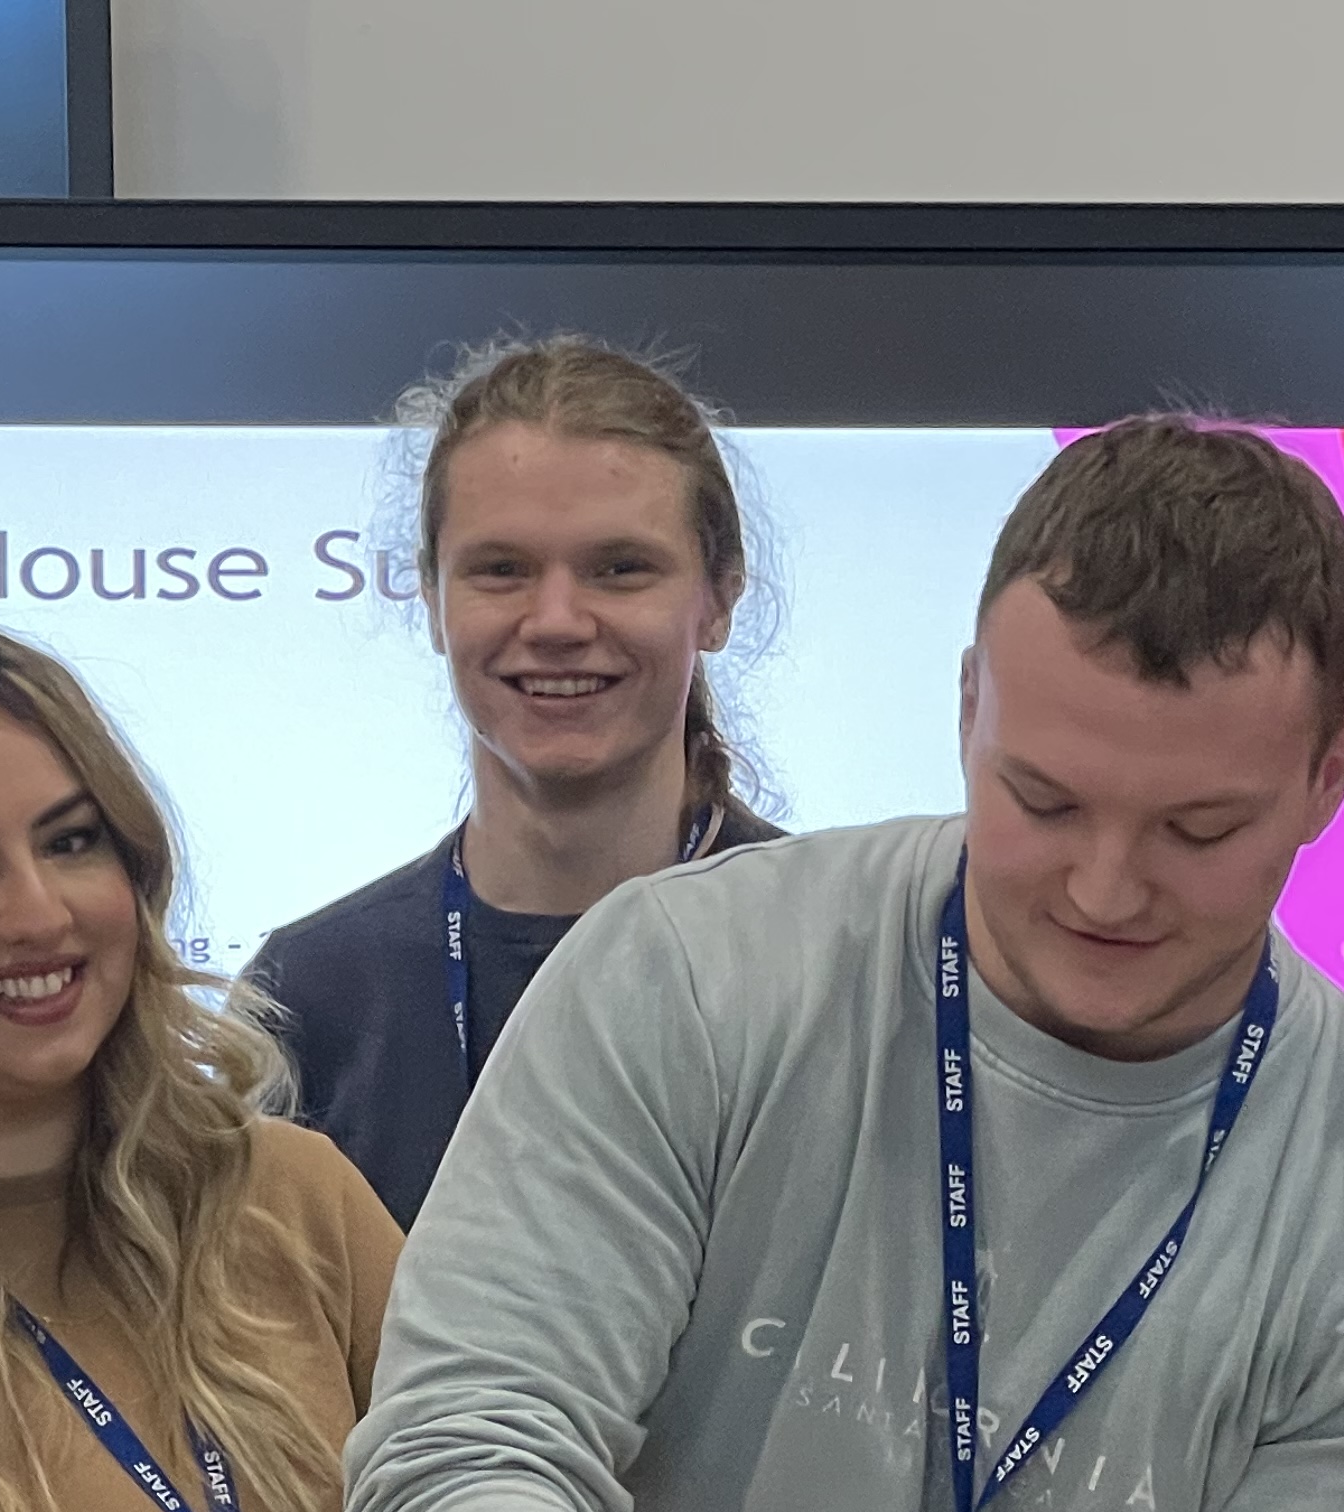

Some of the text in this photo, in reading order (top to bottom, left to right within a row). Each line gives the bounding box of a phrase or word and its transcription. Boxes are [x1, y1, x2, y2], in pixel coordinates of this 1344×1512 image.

[447, 911, 462, 961] STAFF
[942, 935, 960, 998] STAFF
[944, 1048, 964, 1111] STAFF
[1232, 1023, 1265, 1084] STAFF
[949, 1164, 967, 1228] STAFF
[1139, 1239, 1179, 1300] STAFF
[952, 1280, 971, 1344] STAFF
[1067, 1333, 1114, 1394] STAFF
[67, 1377, 113, 1428] STAFF
[956, 1398, 972, 1461] STAFF
[204, 1449, 233, 1506] STAFF
[995, 1426, 1041, 1482] STAFF
[134, 1460, 181, 1512] STAFF
